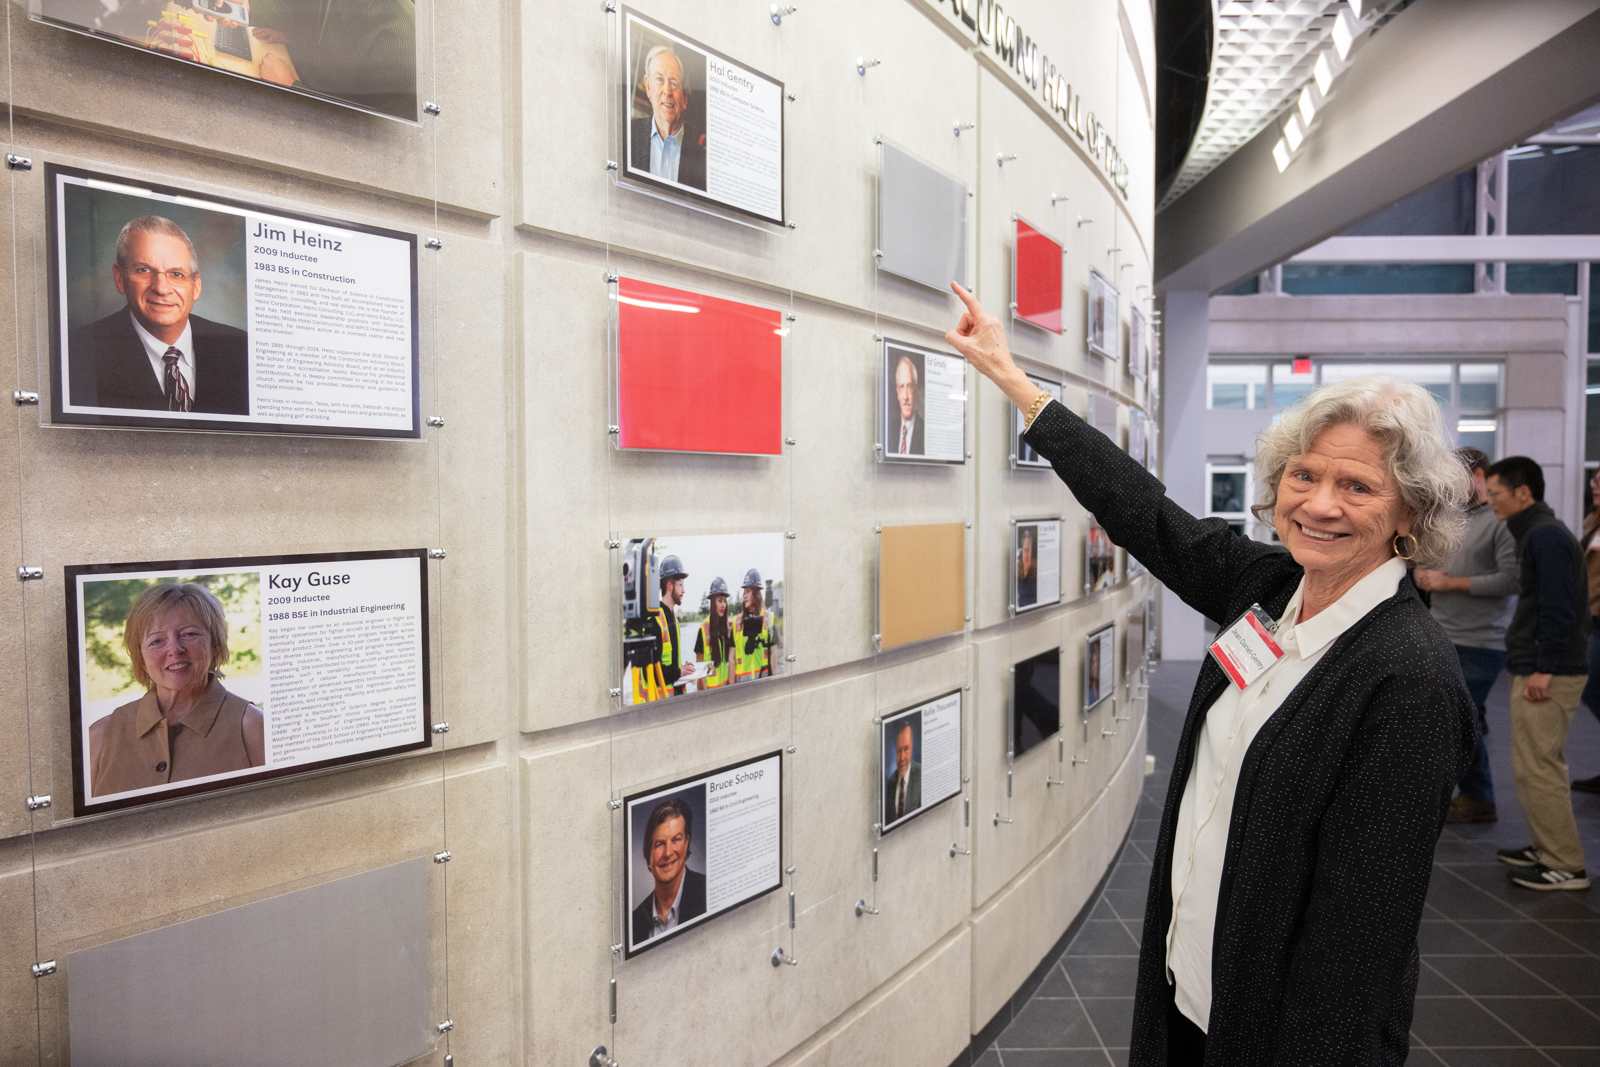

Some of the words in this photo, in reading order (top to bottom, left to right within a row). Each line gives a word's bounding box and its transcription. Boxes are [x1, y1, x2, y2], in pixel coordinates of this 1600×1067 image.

[710, 61, 725, 77] Hal
[727, 69, 755, 93] Gentry
[720, 80, 738, 92] Inductee
[730, 94, 750, 106] Computer
[750, 103, 765, 113] Science
[1042, 55, 1084, 141] HALL
[1086, 111, 1105, 160] OF
[253, 222, 286, 242] Jim
[293, 228, 342, 252] Heinz
[254, 246, 278, 256] 2009
[280, 250, 318, 263] Inductee
[254, 262, 276, 272] 1983
[278, 266, 290, 274] BS
[292, 268, 300, 276] in
[301, 270, 356, 284] Construction
[268, 574, 302, 592] Kay
[308, 572, 350, 586] Guse
[268, 596, 291, 605] 2009
[294, 594, 330, 602] Inductee
[268, 612, 290, 620] 1988
[292, 610, 308, 619] BSE
[320, 606, 358, 616] Industrial
[360, 602, 406, 614] Engineering
[1232, 629, 1242, 641] Jean
[1240, 638, 1264, 670] Daniel-Gentry
[710, 782, 734, 793] Bruce
[735, 769, 764, 784] Schopp
[720, 791, 738, 800] Inductee
[738, 794, 760, 804] Engineering
